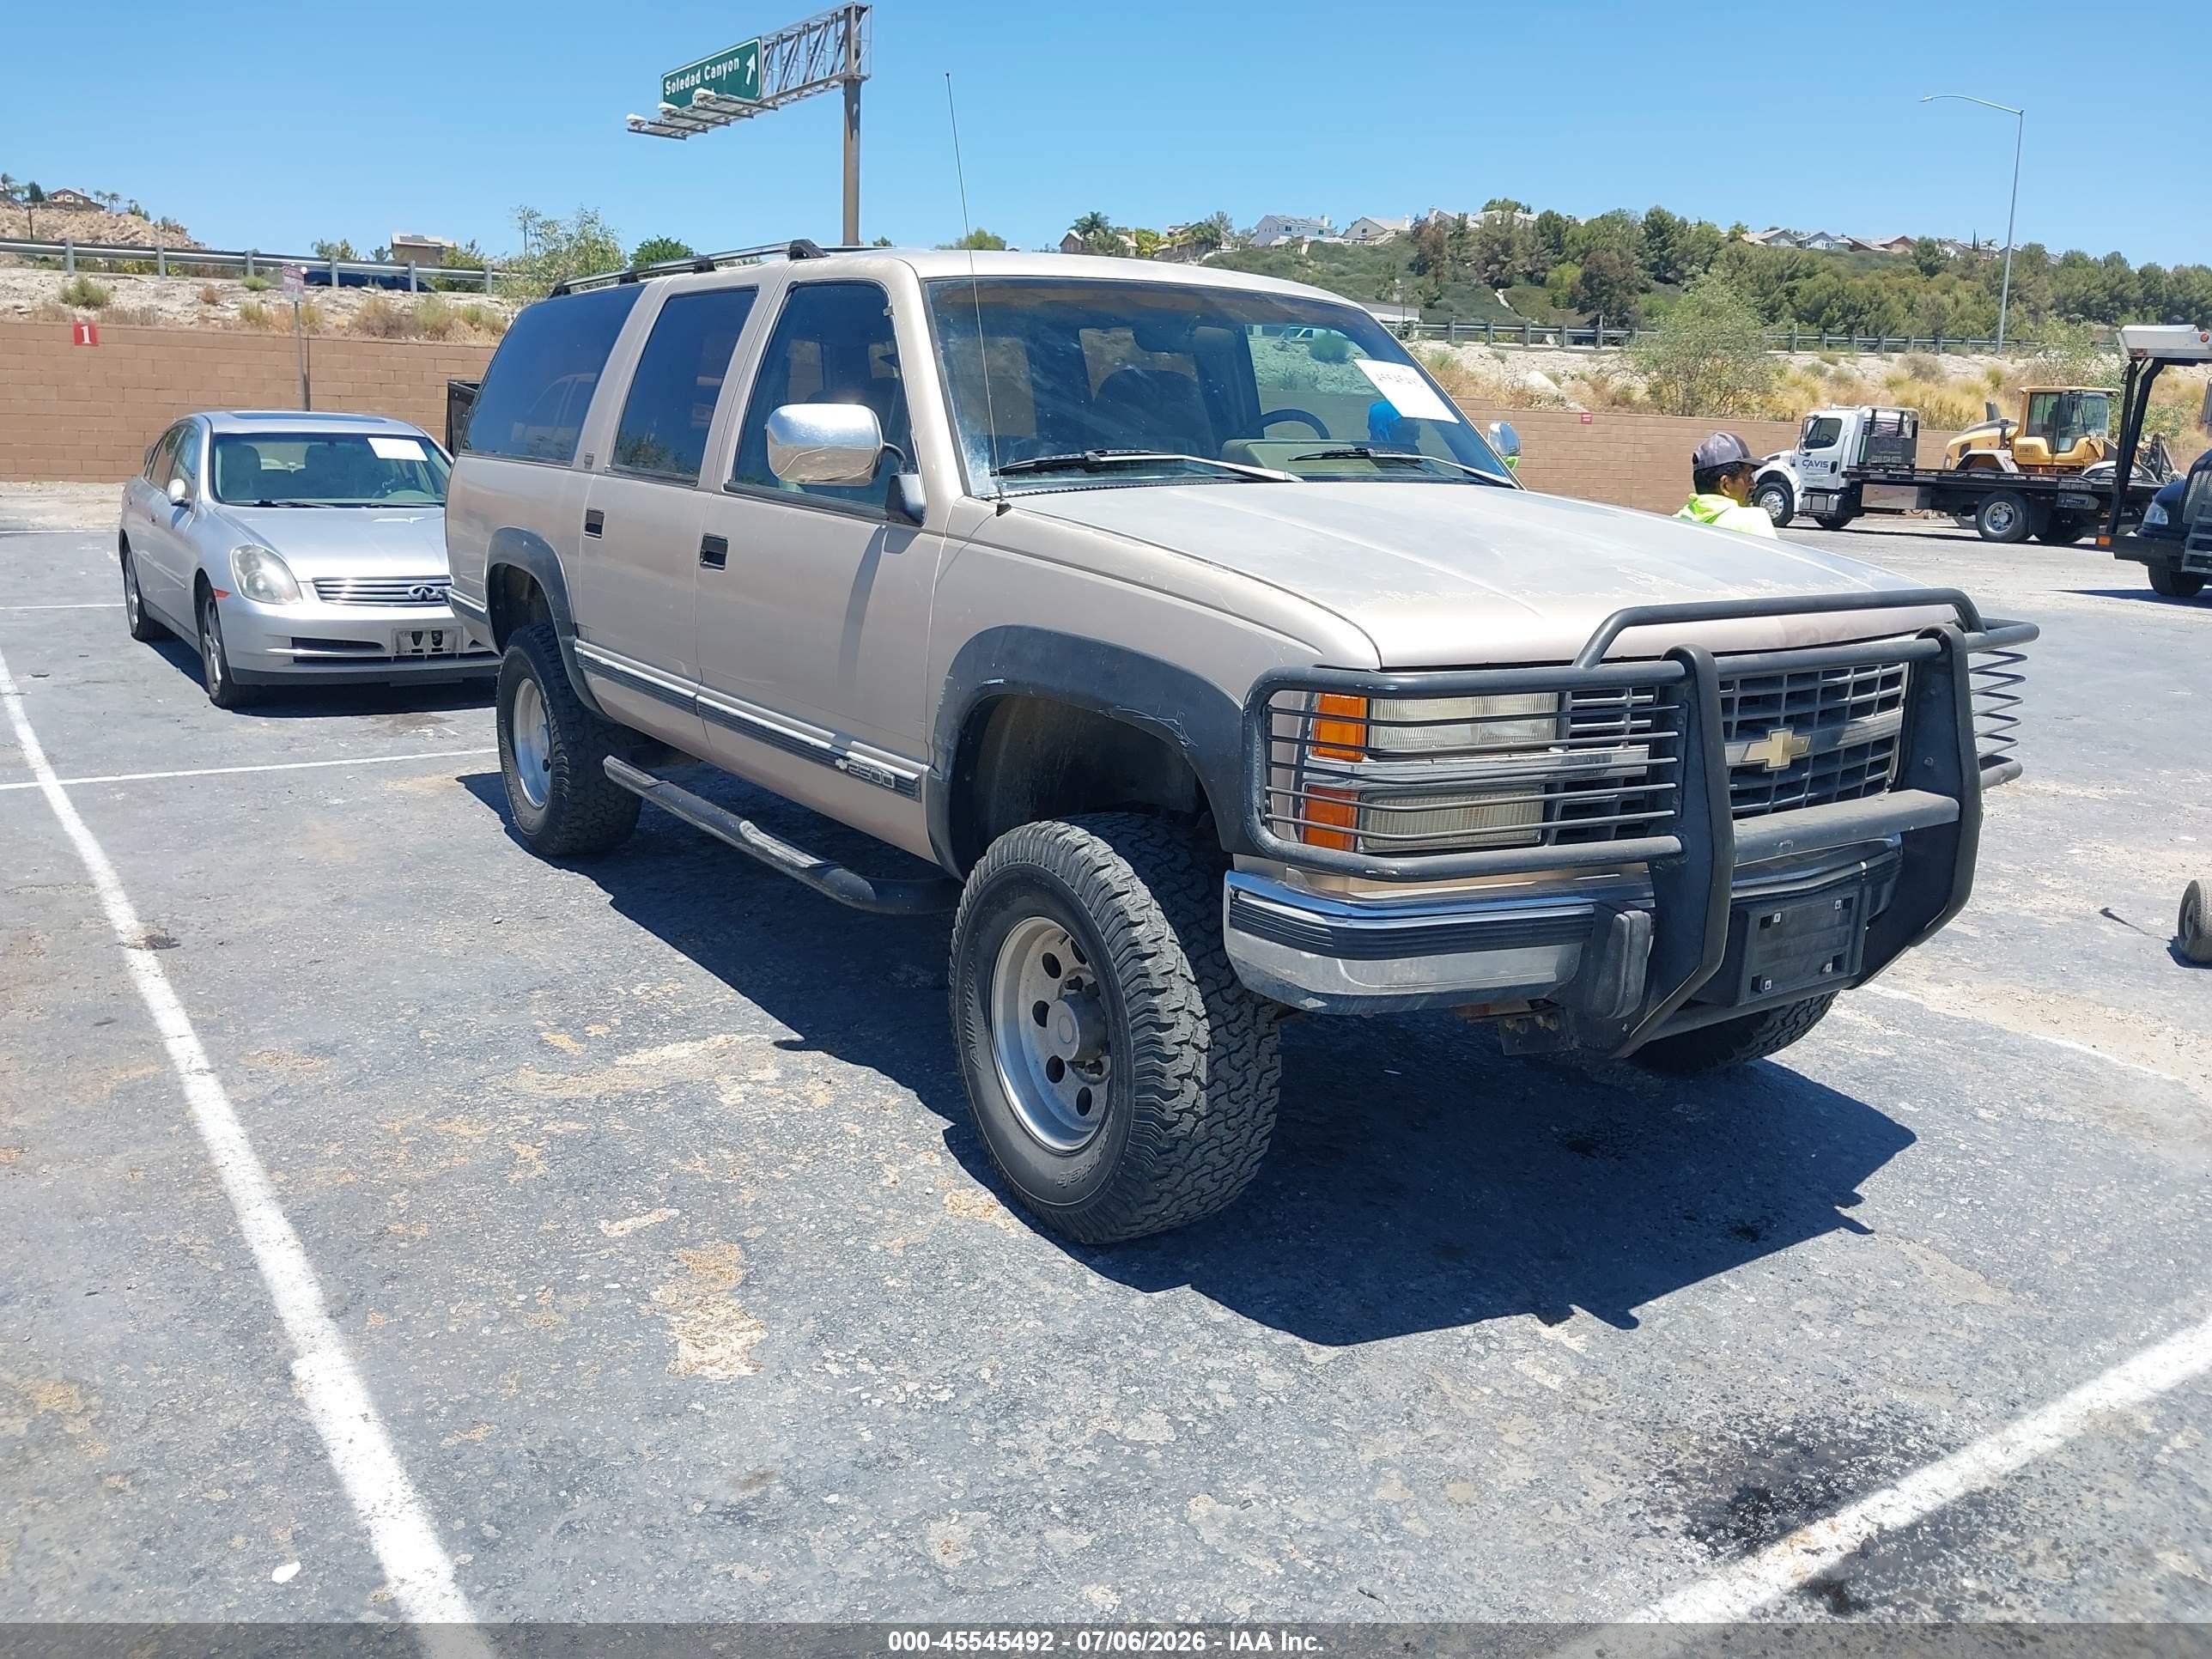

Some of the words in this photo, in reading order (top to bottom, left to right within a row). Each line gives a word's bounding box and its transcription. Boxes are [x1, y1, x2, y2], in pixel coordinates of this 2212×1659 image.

[665, 69, 702, 96] Soledad
[703, 57, 740, 82] Canyon
[80, 325, 92, 344] 1
[1802, 459, 1829, 470] CAVIS
[848, 761, 896, 789] 2500
